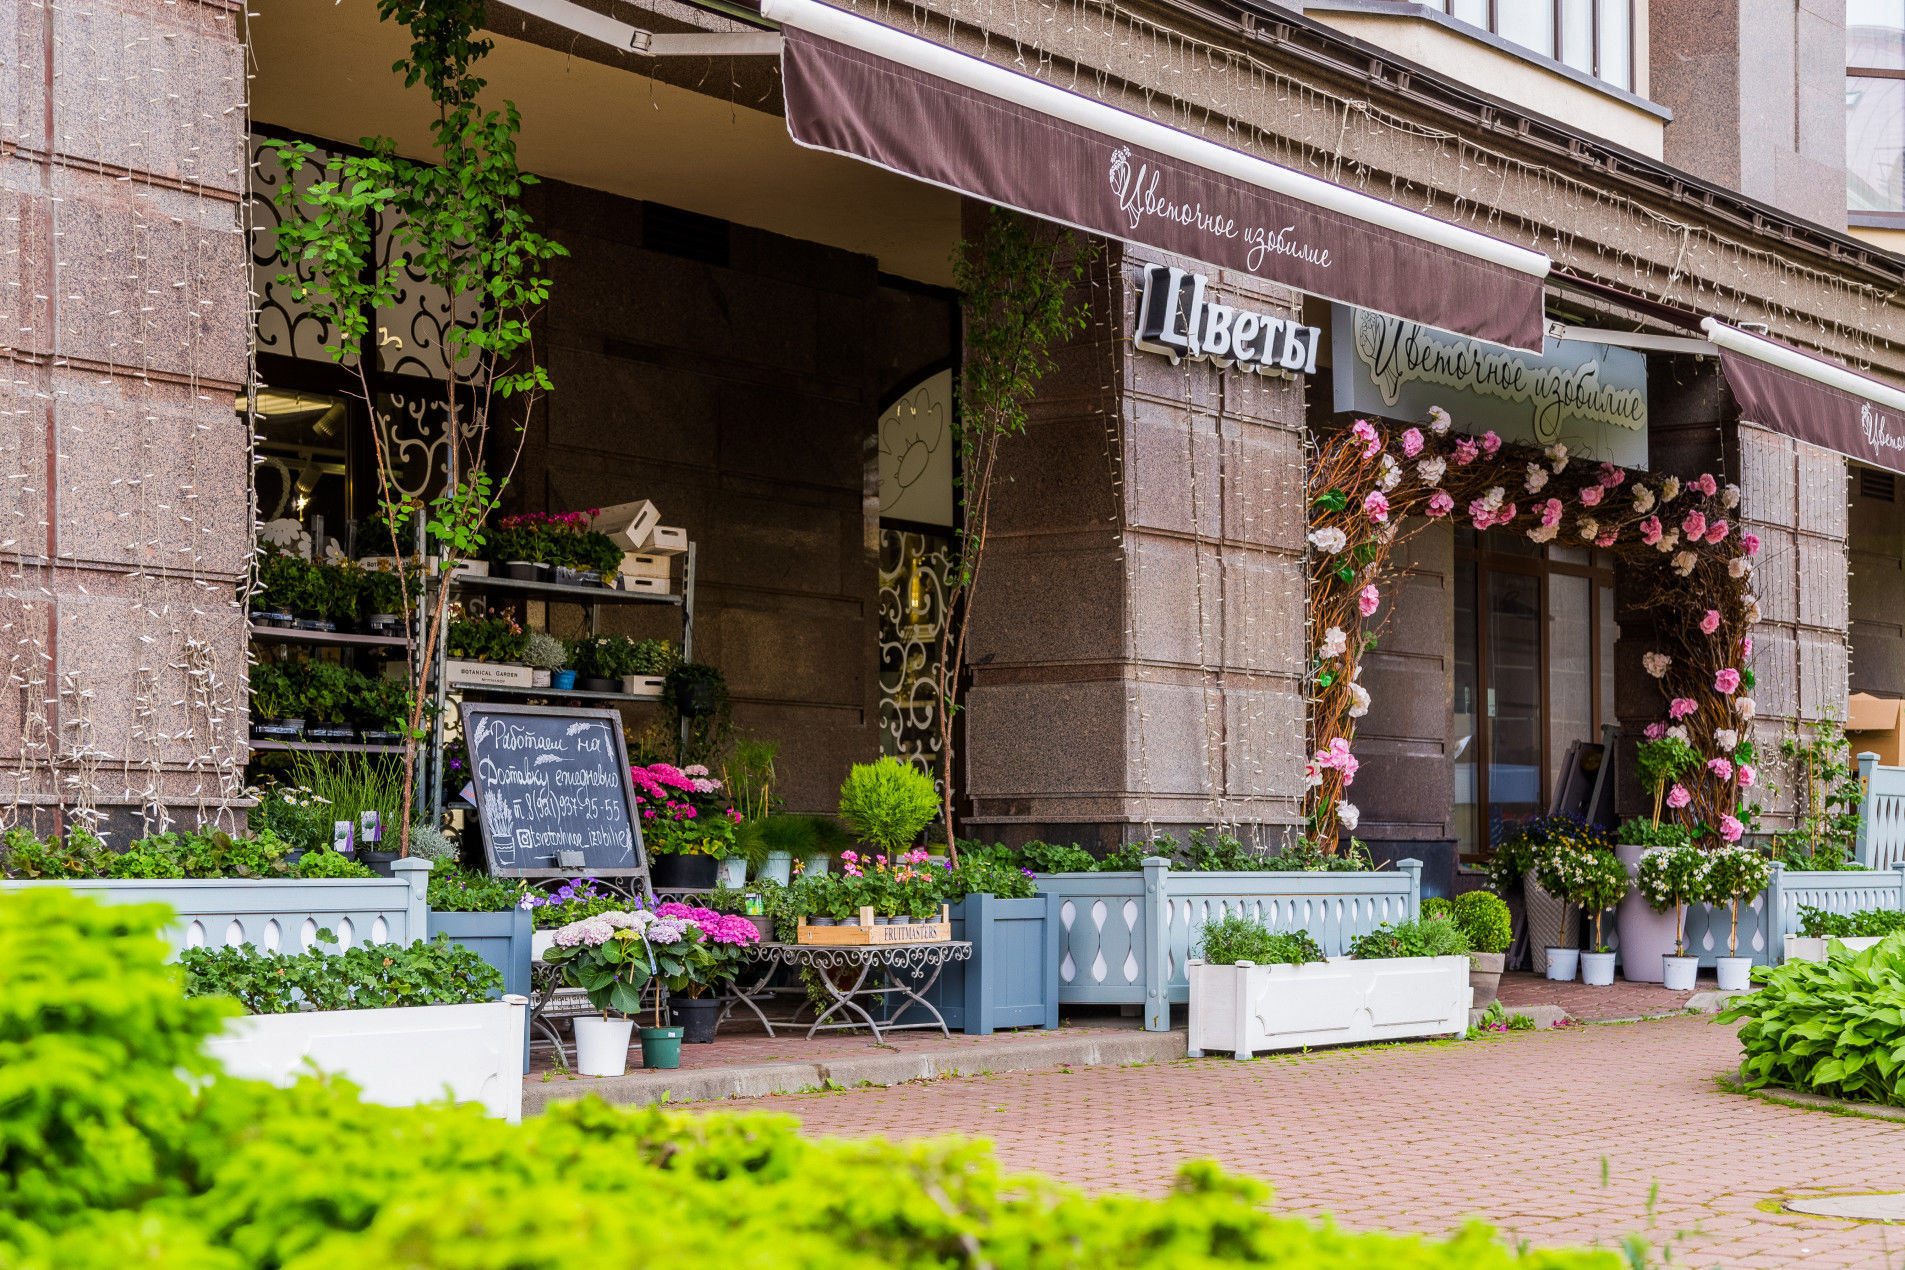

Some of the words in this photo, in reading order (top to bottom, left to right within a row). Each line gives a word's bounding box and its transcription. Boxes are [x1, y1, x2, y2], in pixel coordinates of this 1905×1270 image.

[1112, 160, 1238, 238] Цветочное
[1245, 225, 1332, 272] изобилие
[1150, 265, 1321, 376] Цветы
[1370, 312, 1527, 398] Цветочное
[1535, 369, 1644, 436] изобилие
[490, 720, 568, 751] Работаем
[577, 737, 602, 753] на
[884, 925, 937, 941] FRUITMASTERS
